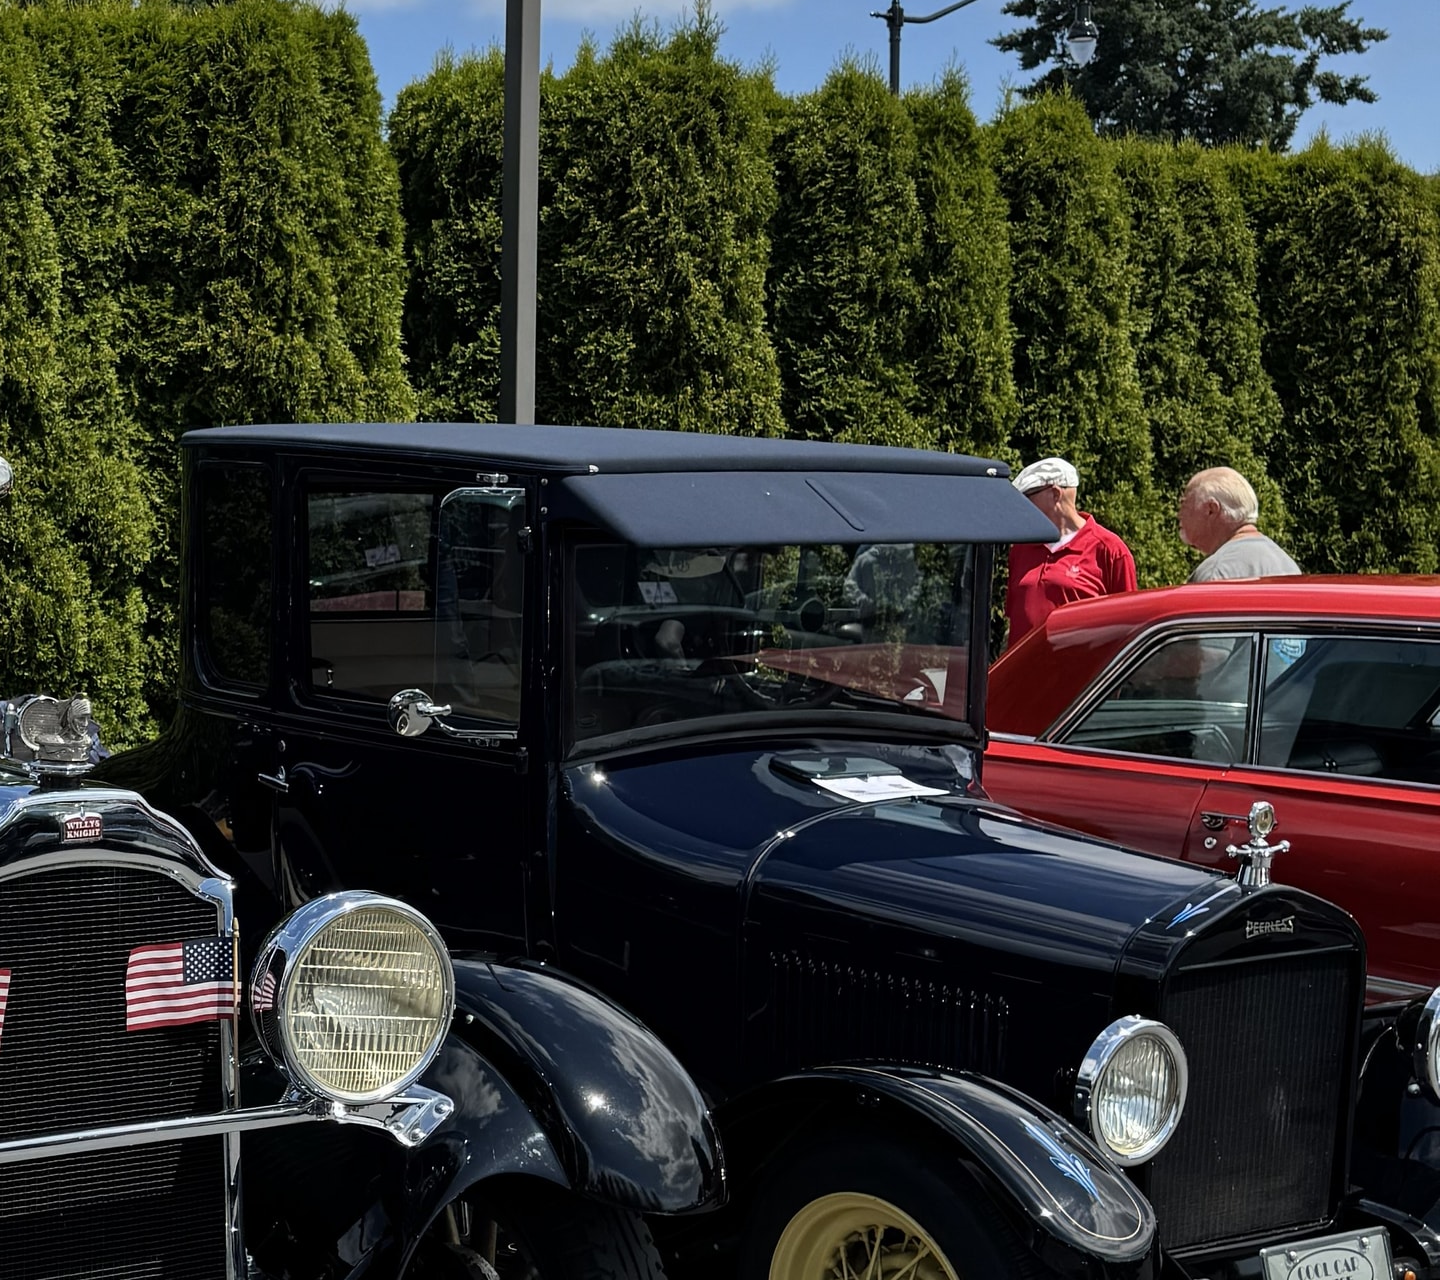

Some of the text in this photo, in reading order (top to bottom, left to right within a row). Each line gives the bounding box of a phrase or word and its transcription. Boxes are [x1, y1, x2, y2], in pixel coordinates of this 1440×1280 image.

[66, 819, 101, 830] WILLYS
[66, 828, 101, 839] KNIGHT
[1246, 915, 1295, 939] PEERLESS
[1333, 1256, 1360, 1276] CAR
